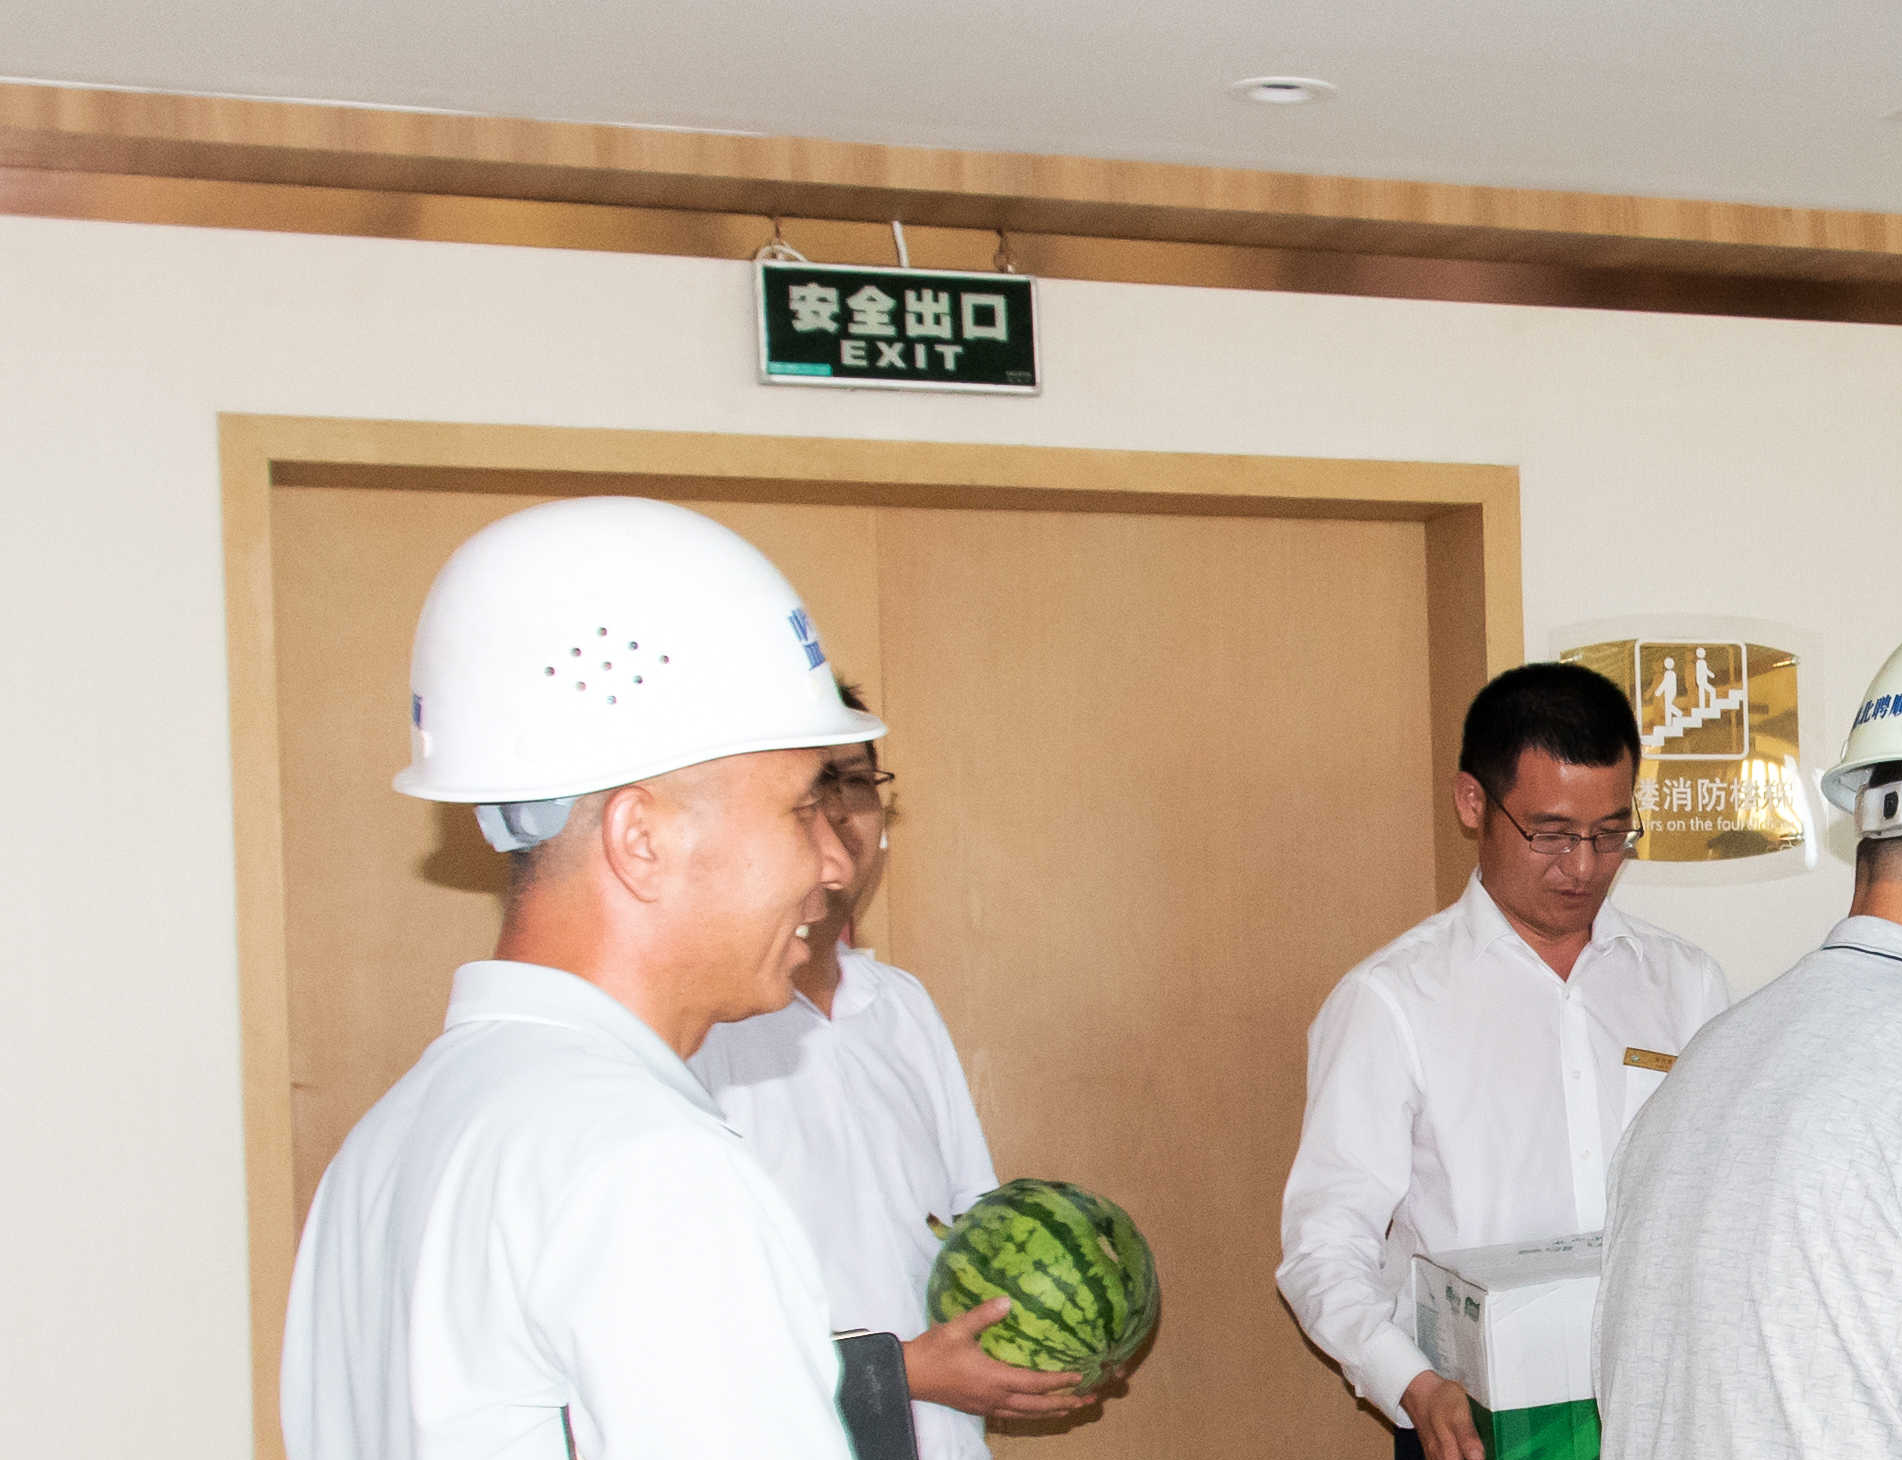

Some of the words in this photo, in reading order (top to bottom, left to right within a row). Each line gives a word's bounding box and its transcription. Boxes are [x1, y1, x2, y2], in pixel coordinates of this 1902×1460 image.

[788, 281, 1009, 343] 安全出口
[840, 338, 963, 372] EXIT
[1666, 820, 1686, 832] on
[1689, 817, 1713, 832] the
